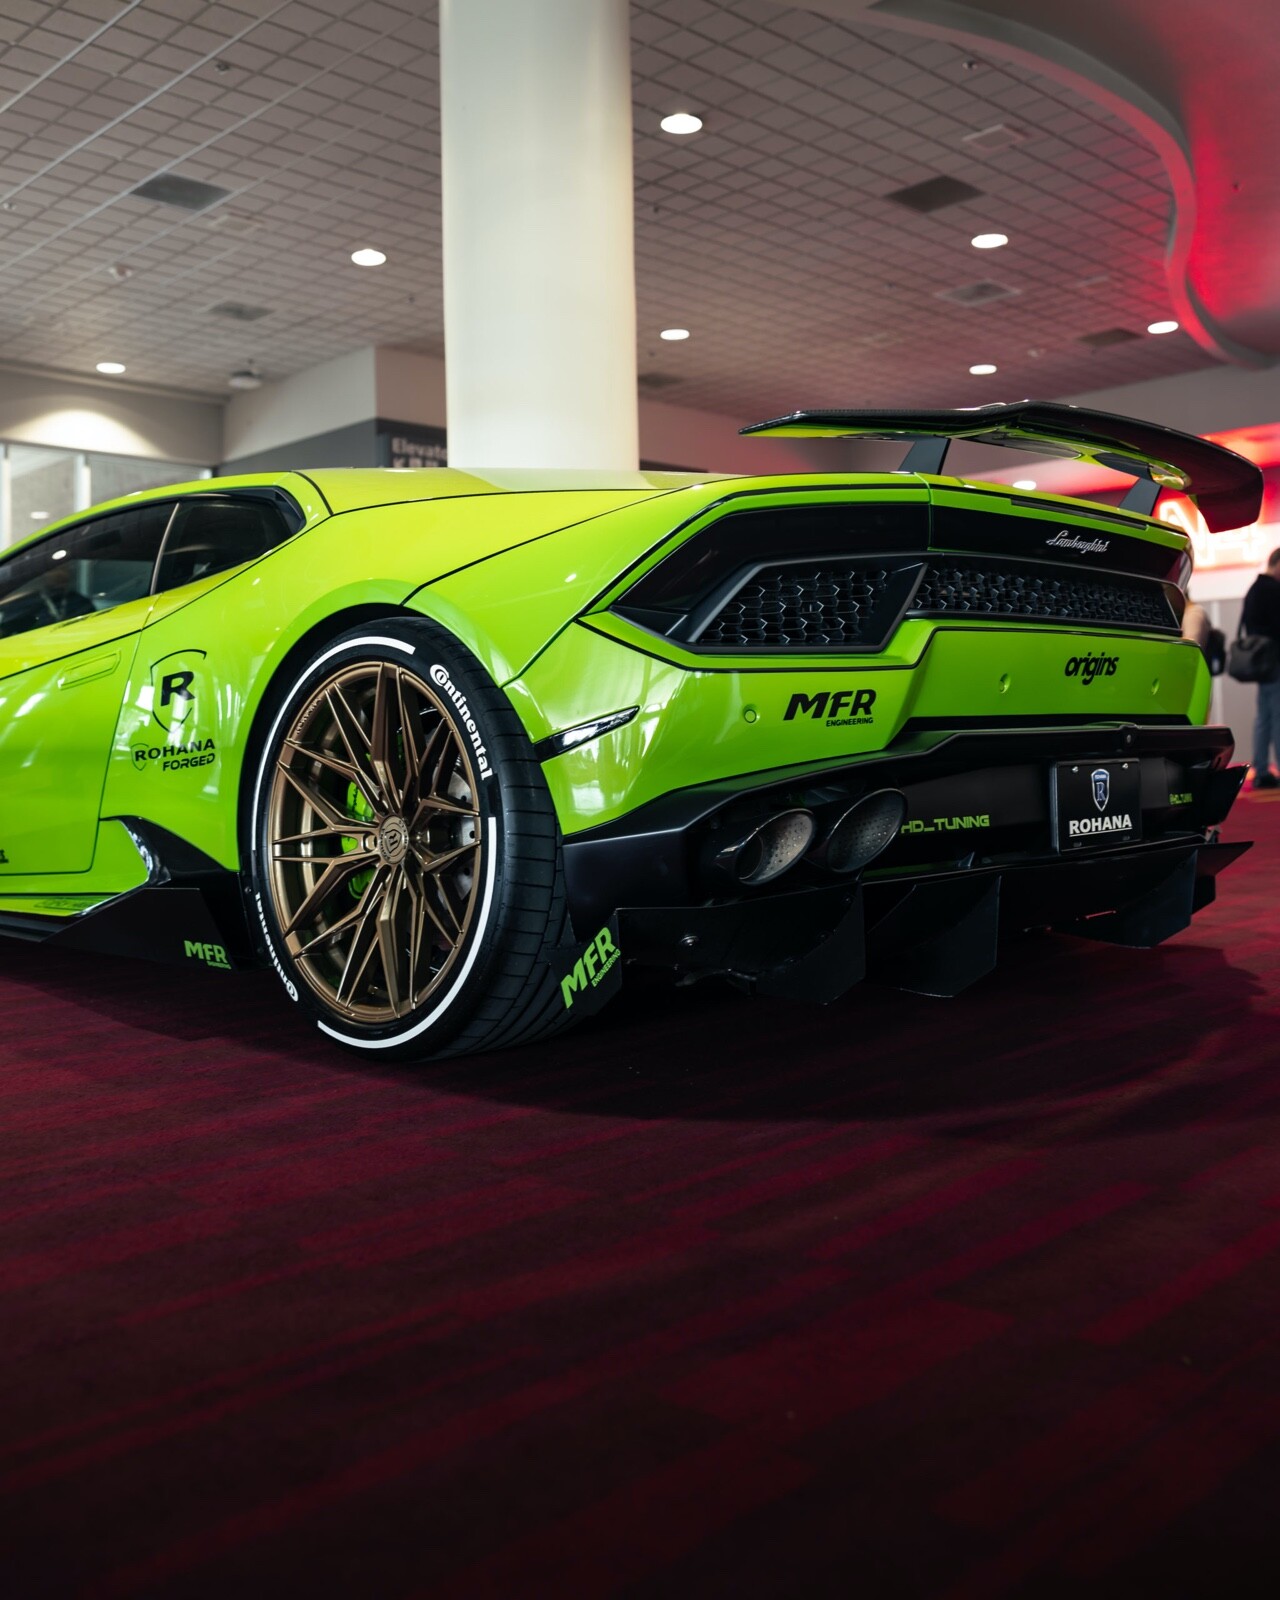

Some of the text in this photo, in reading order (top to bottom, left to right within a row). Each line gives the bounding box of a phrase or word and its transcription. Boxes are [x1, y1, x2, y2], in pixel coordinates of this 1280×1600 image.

[1065, 652, 1119, 685] origins
[160, 671, 195, 706] R
[783, 689, 877, 721] MFR
[429, 664, 493, 780] Continental
[826, 717, 873, 727] ENGINEERING
[135, 739, 215, 761] ROHANA
[163, 753, 215, 771] FORGED
[1069, 814, 1132, 835] ROHANA
[184, 940, 228, 963] MFR
[560, 927, 616, 1009] MFR
